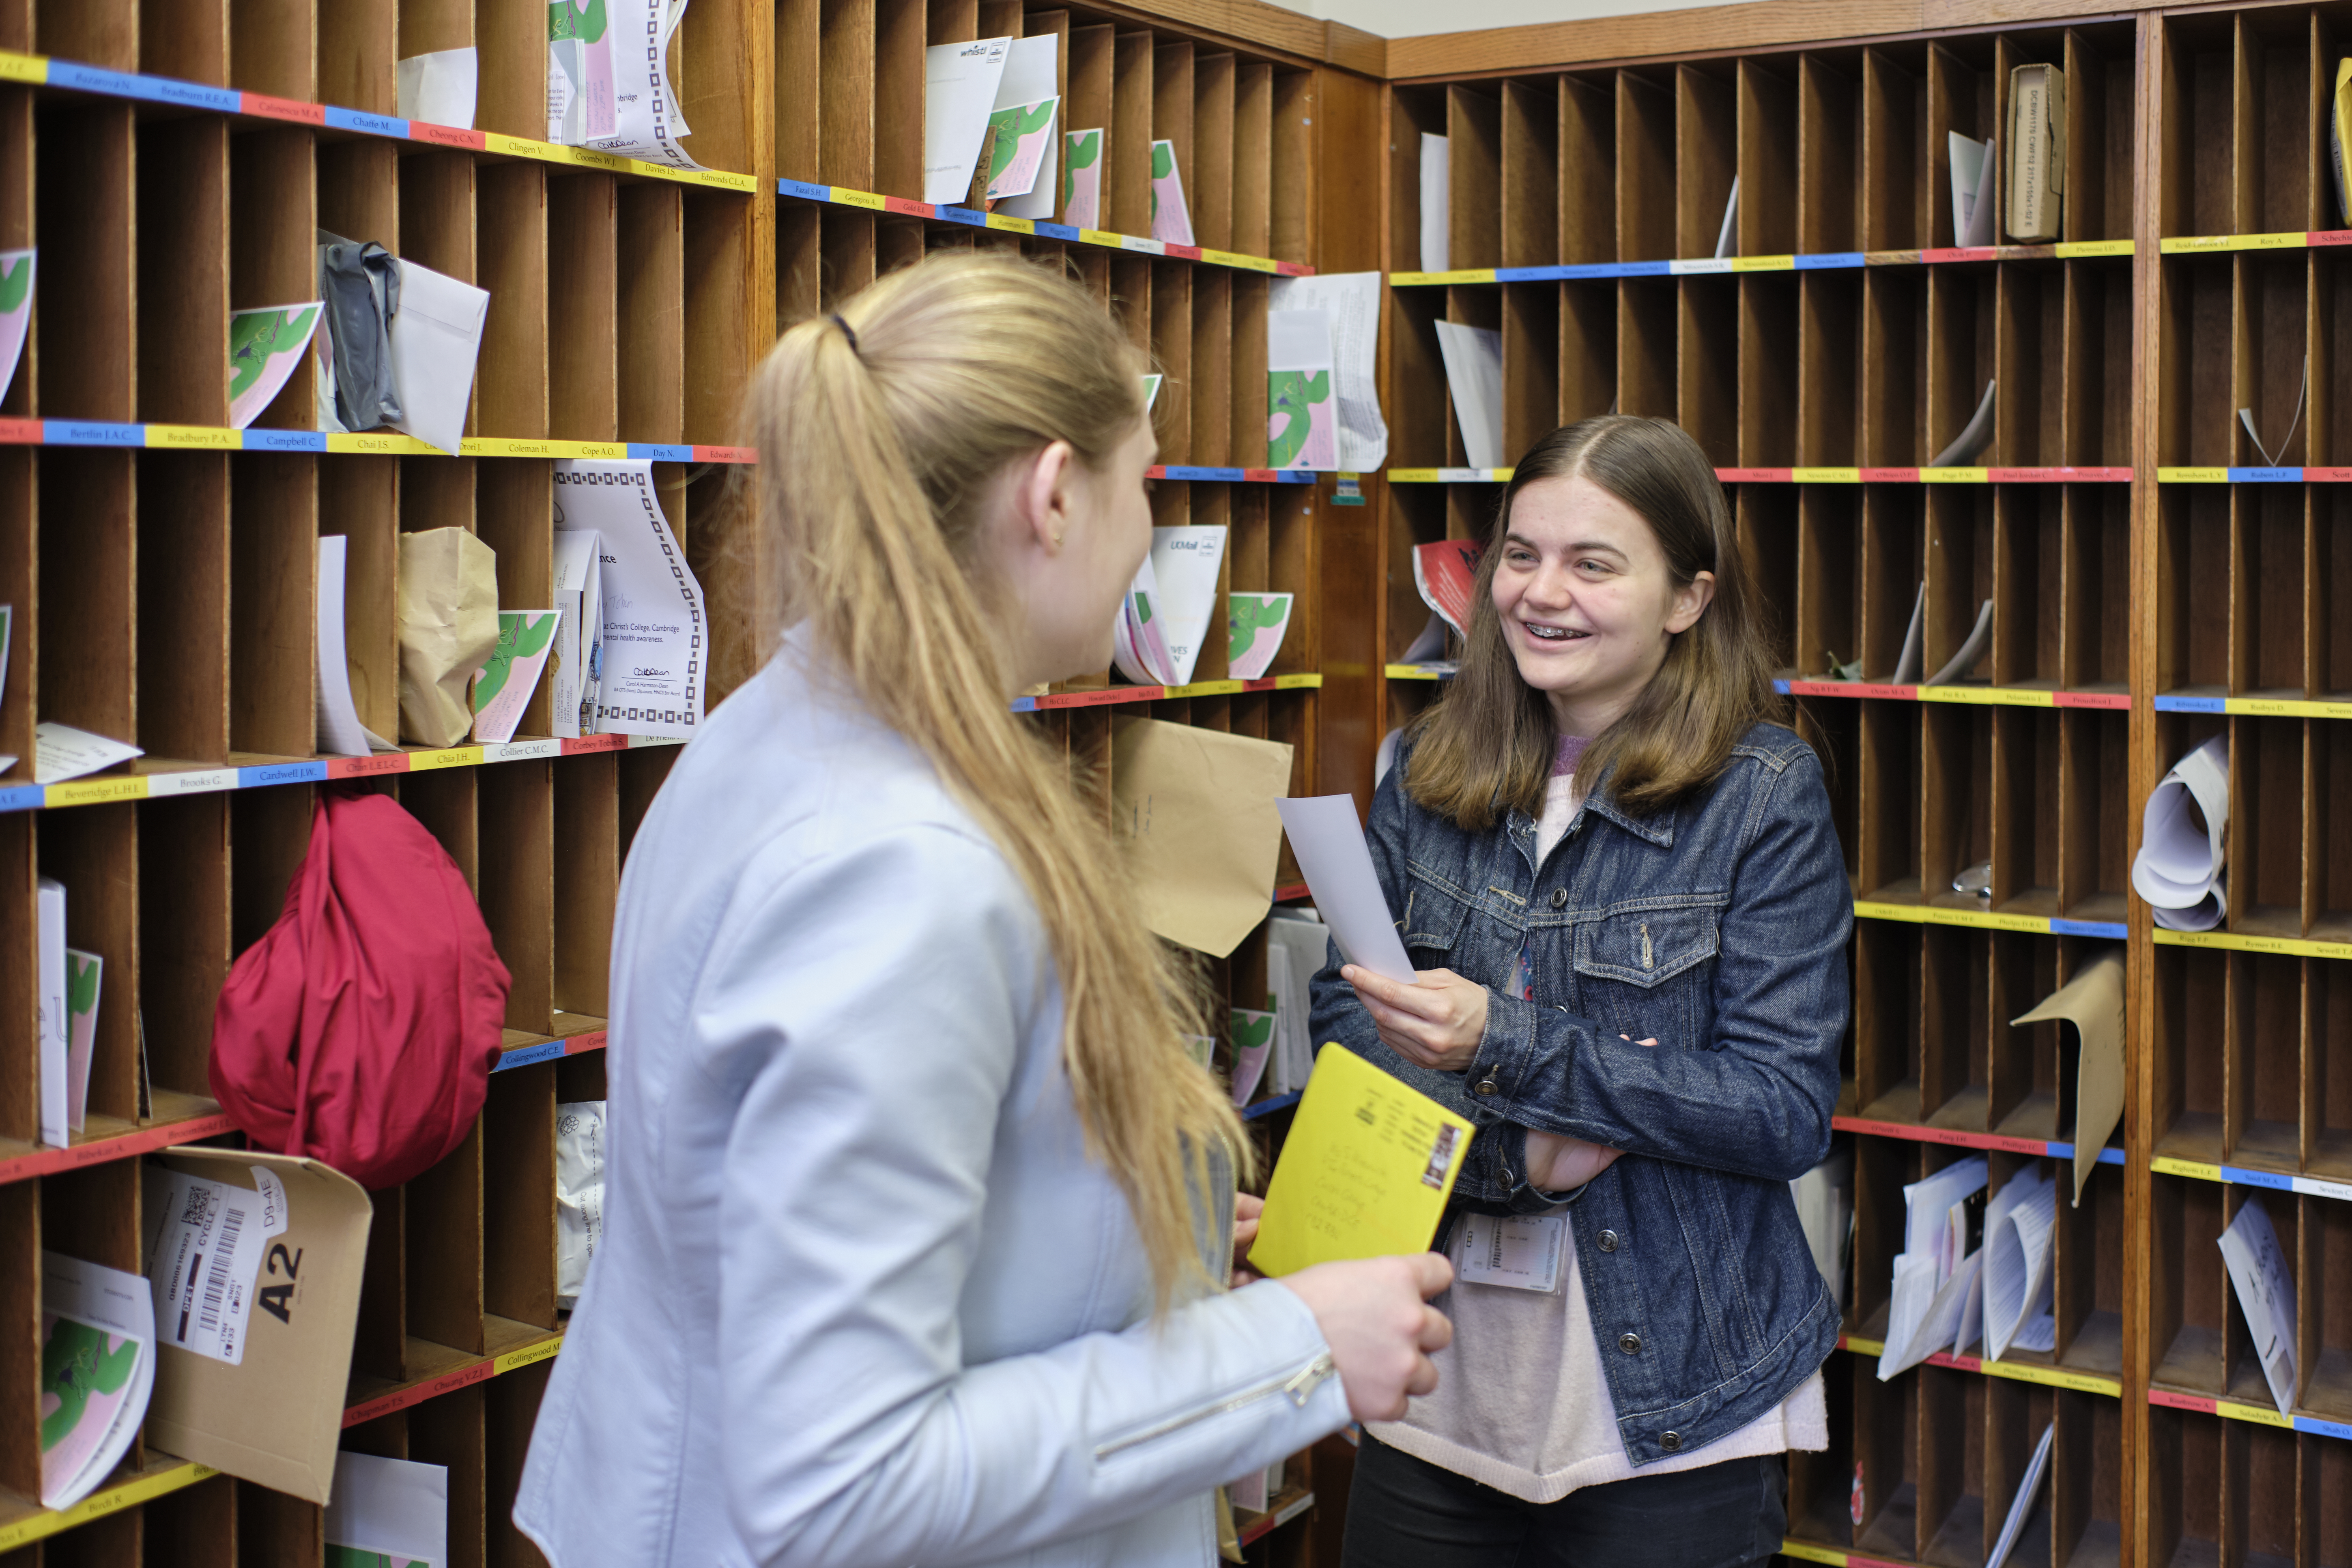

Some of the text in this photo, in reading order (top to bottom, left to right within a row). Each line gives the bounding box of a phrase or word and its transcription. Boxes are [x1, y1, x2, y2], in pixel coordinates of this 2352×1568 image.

[960, 45, 987, 57] whistl
[161, 86, 231, 105] Bradburn R.E.A.
[353, 116, 391, 131] Chaffe M.
[429, 129, 476, 144] Cheong C.N.
[509, 143, 544, 155] Clingen V.
[575, 153, 602, 165] Coombs
[604, 158, 617, 168] W.J.
[645, 163, 665, 174] Davies
[701, 173, 746, 186] Edmonds C.L.A.
[795, 185, 810, 194] Fazal
[845, 193, 869, 205] Georgiou
[167, 432, 230, 445] Bradbury P.A.
[267, 435, 318, 448] Campbell C.
[357, 440, 389, 450] Chai J.S.
[508, 444, 550, 454] Coleman H.
[582, 447, 615, 457] Cope A.O.
[653, 449, 675, 460] Day N.
[710, 450, 736, 459] Edwards
[610, 622, 629, 631] Christ's
[630, 623, 651, 632] College,
[652, 624, 680, 633] Cambridge
[500, 745, 549, 757] Collier C.M.C.
[573, 738, 625, 752] Corbey Tobin S.
[437, 753, 471, 764] Chia J.H.
[260, 767, 318, 781] Cardwell J.W.
[180, 776, 223, 788] Brooks G.
[64, 787, 111, 800] Beveridge
[505, 1046, 561, 1065] Collingwood C.E.
[182, 1285, 194, 1312] DPE1
[199, 1209, 217, 1247] CYCLE
[258, 1242, 303, 1325] A2
[220, 1322, 228, 1342] LTN4
[507, 1342, 562, 1366] Collingwood M.
[434, 1376, 464, 1391] Chuang
[351, 1395, 405, 1421] Chapman T.S.
